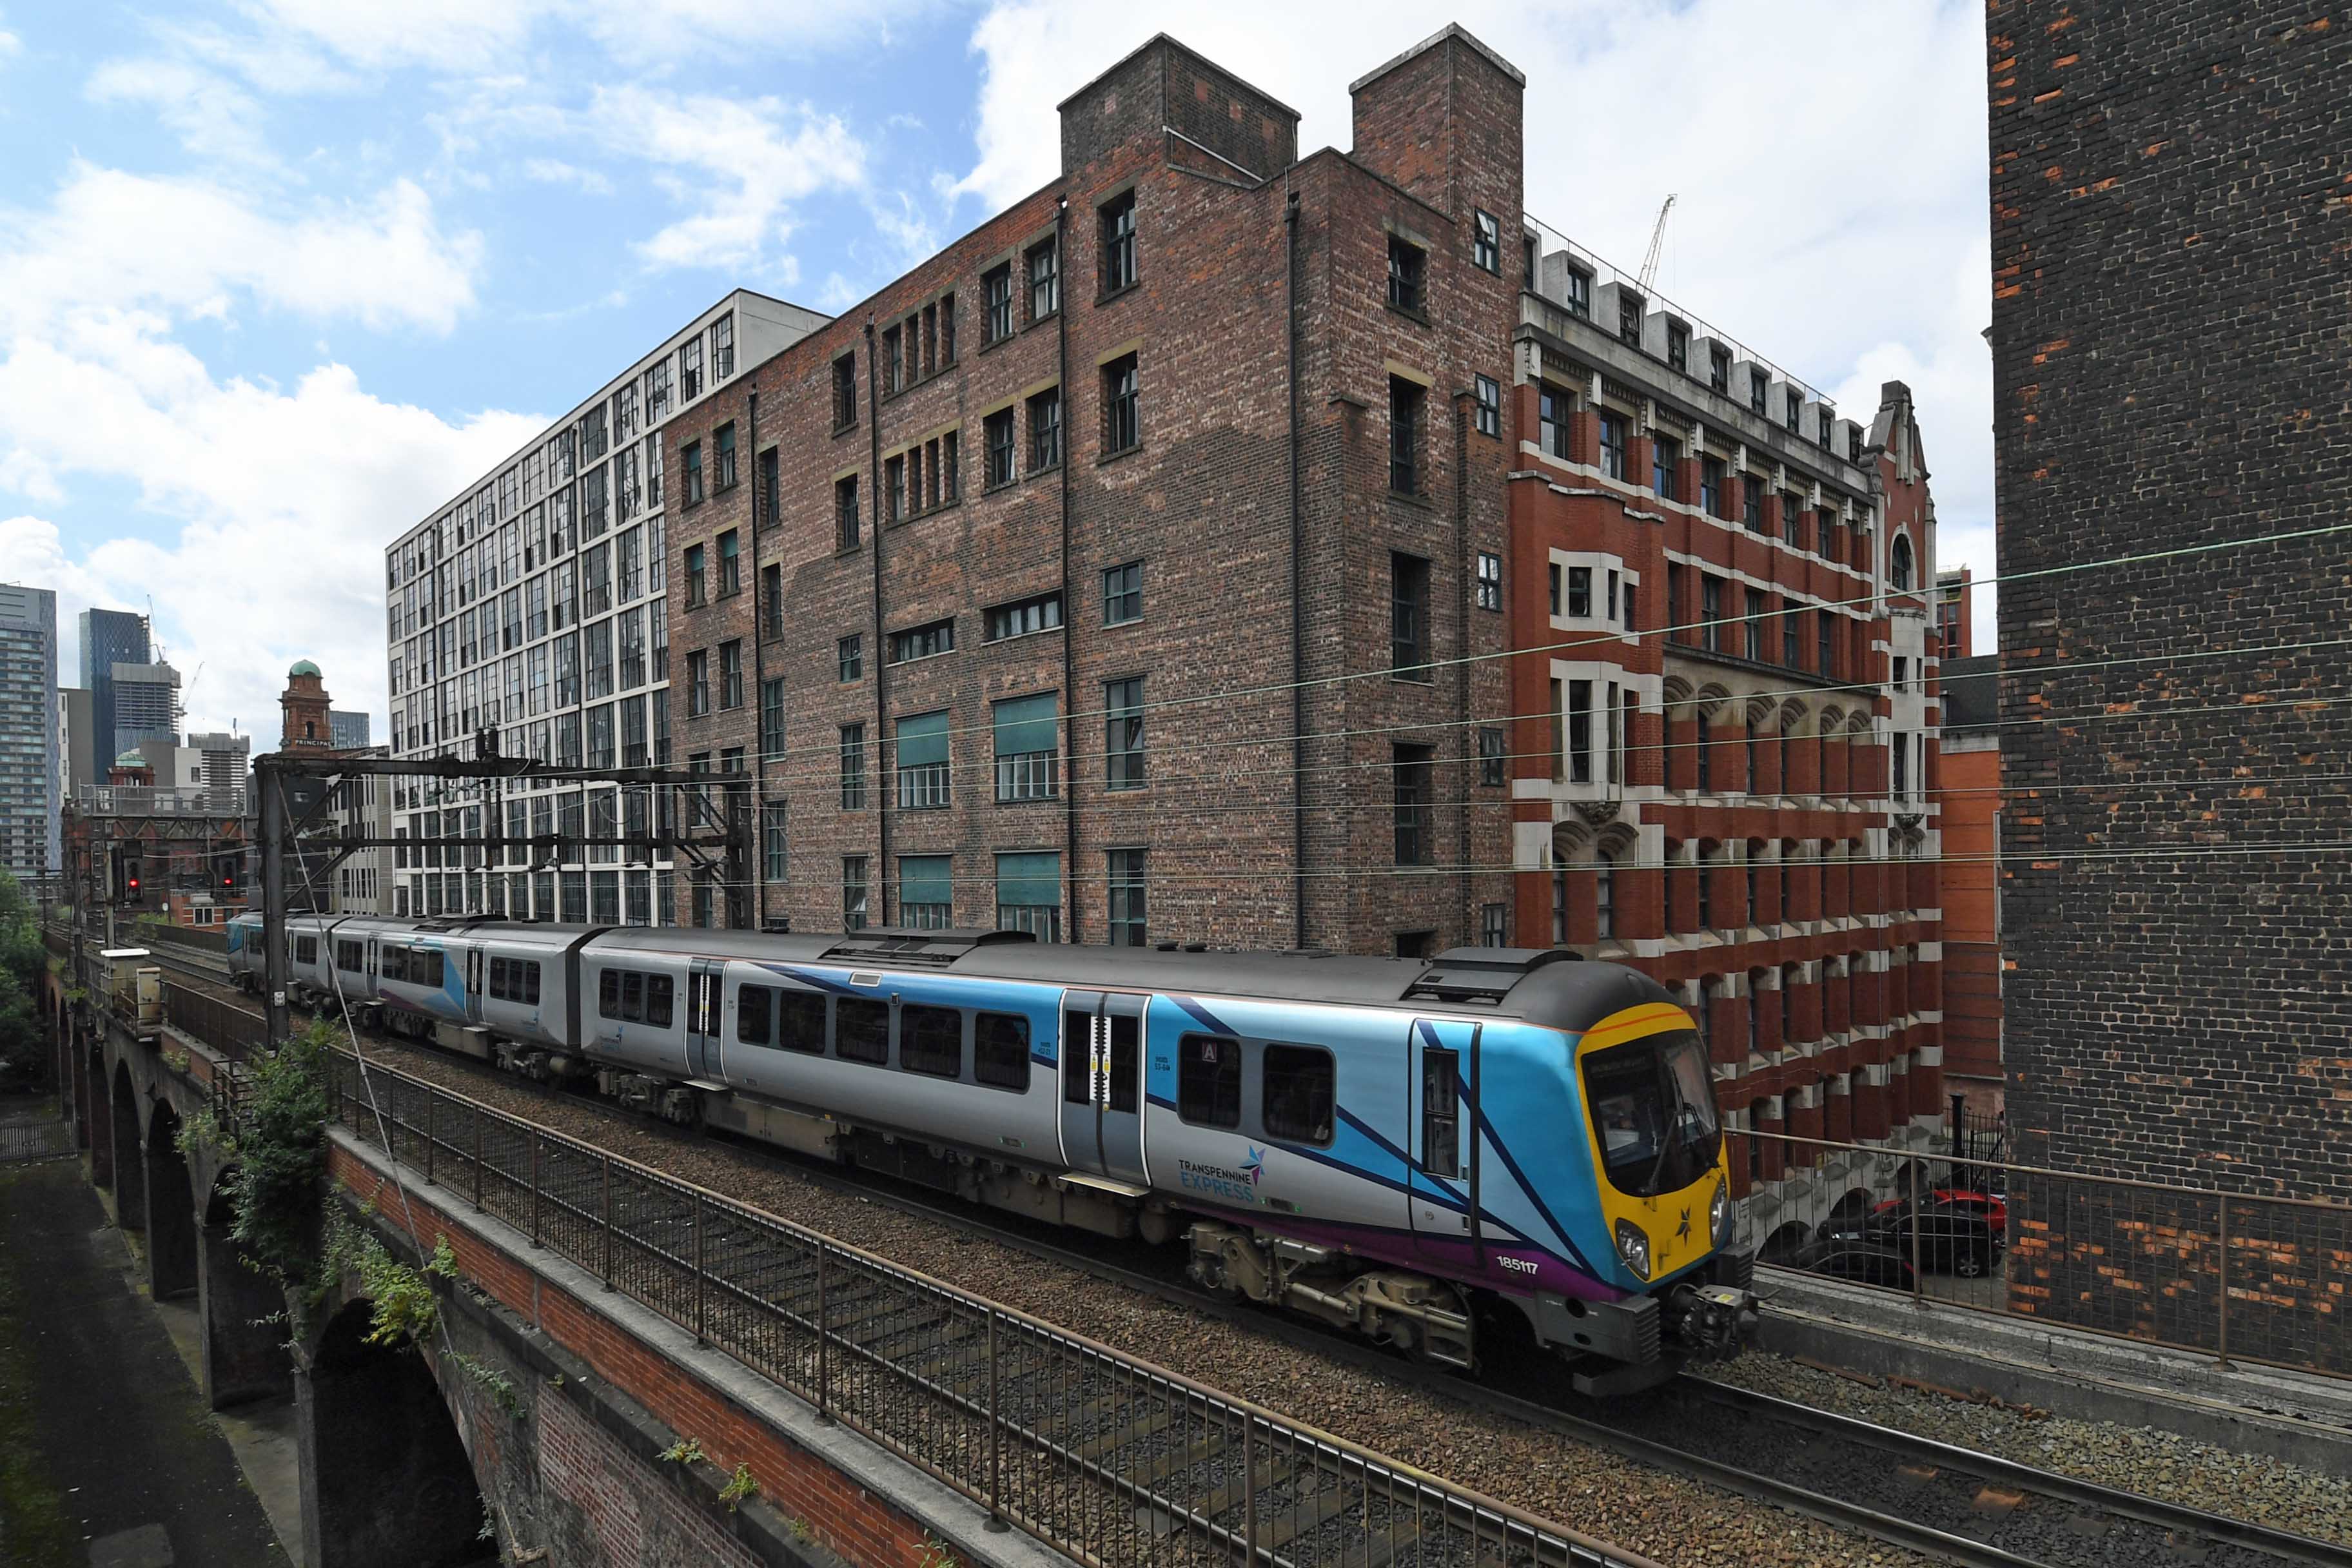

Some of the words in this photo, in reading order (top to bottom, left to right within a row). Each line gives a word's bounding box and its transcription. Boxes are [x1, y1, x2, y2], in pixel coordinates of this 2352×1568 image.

[1204, 1043, 1214, 1059] A
[1179, 1159, 1251, 1185] TRANSPENNINE
[1181, 1171, 1254, 1202] EXPRESS
[1496, 1256, 1538, 1275] 185117
